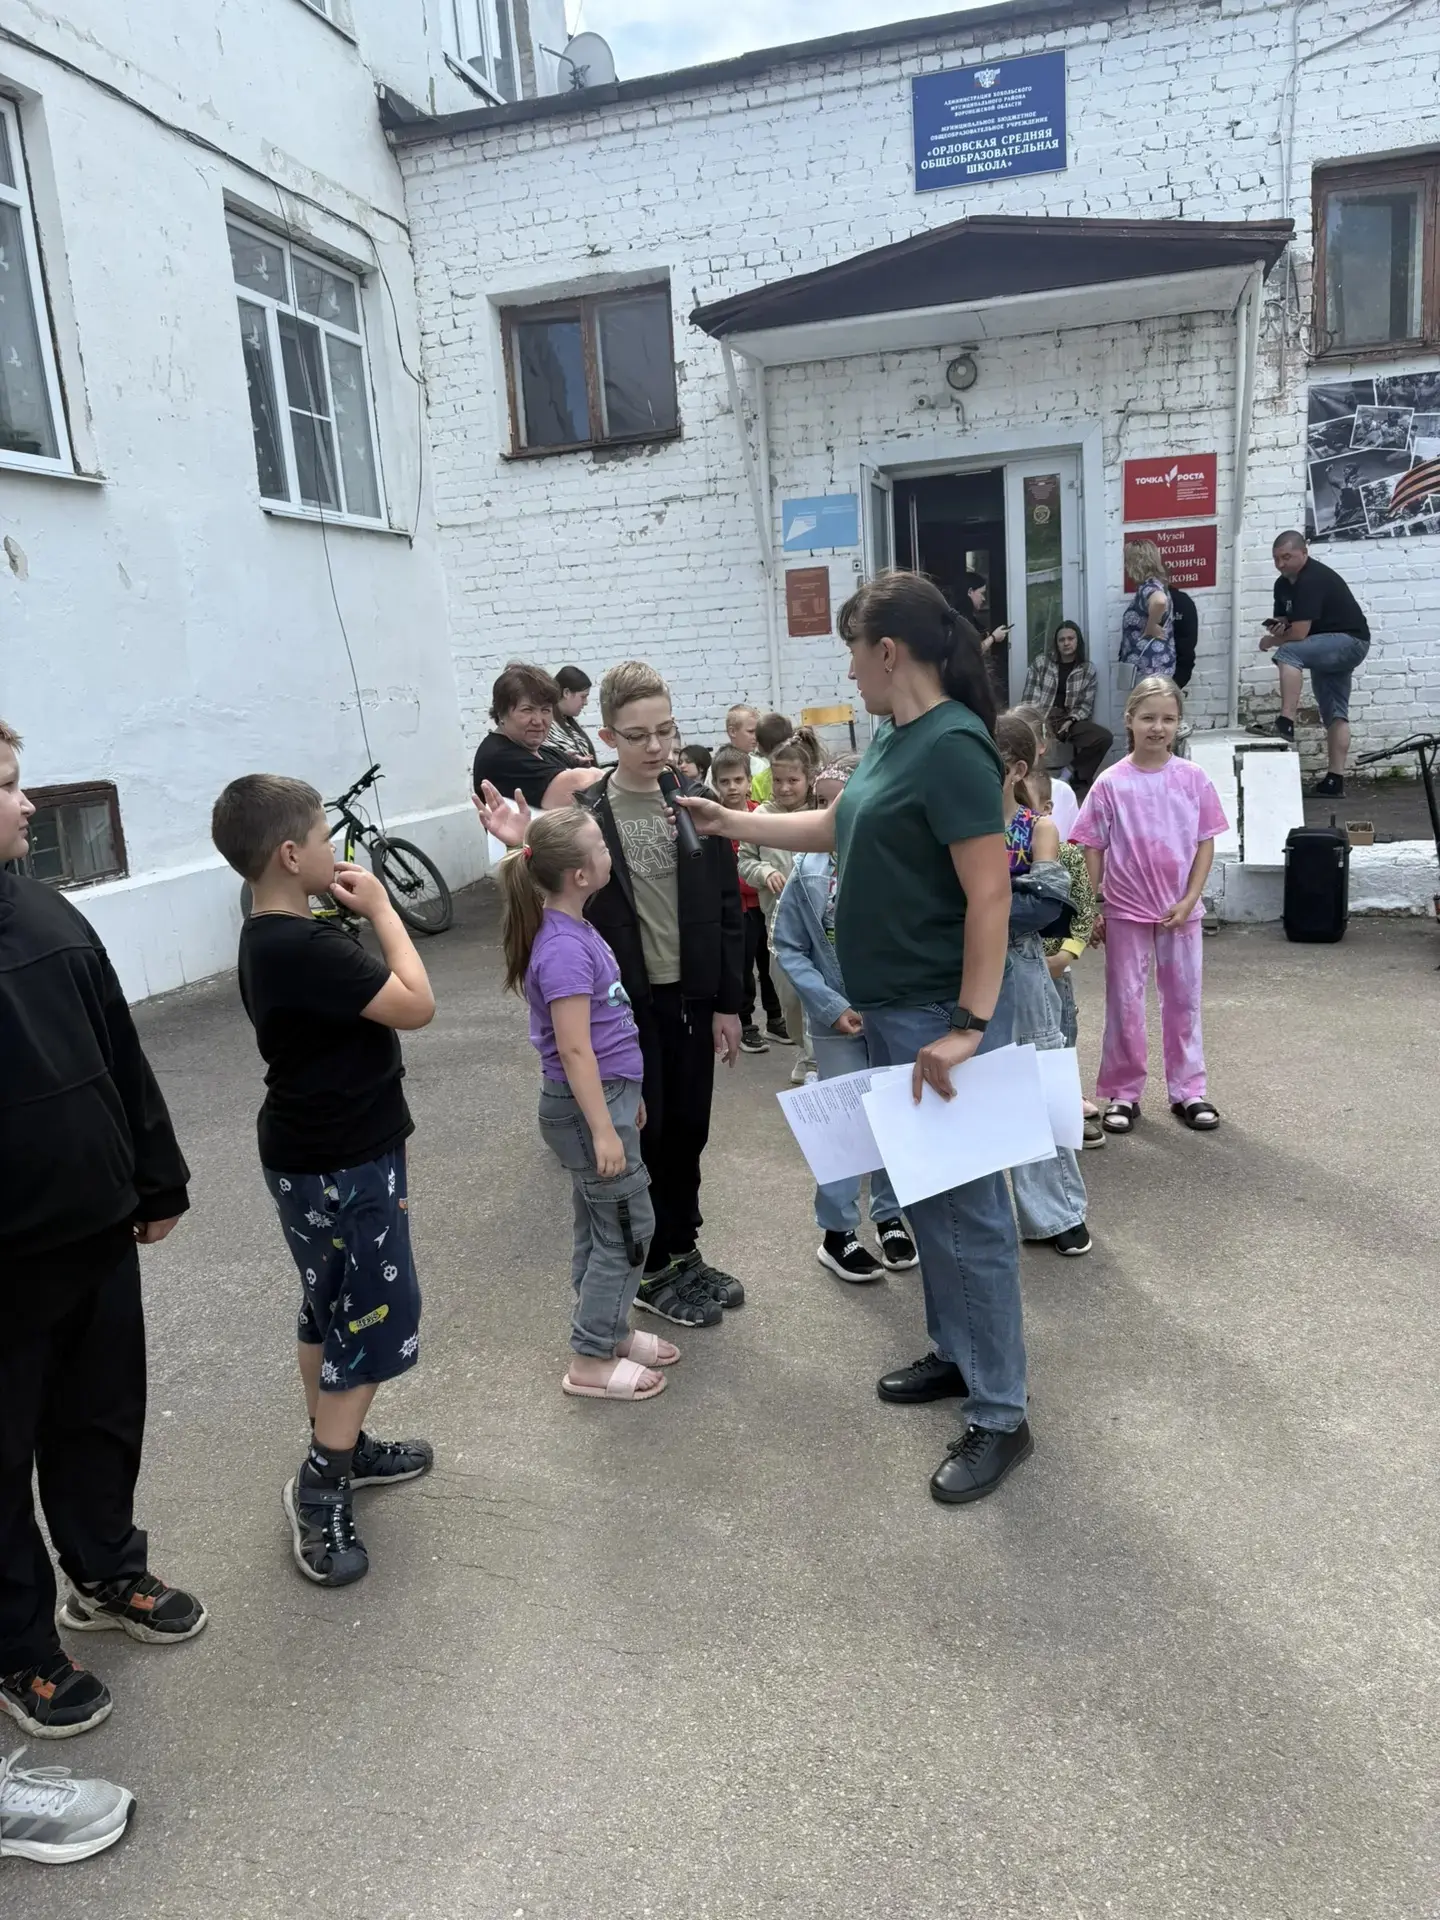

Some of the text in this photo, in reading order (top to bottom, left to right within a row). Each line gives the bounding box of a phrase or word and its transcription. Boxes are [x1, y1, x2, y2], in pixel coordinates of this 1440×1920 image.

[1001, 128, 1053, 145] СРЕДНЯЯ
[920, 139, 1059, 170] ОБЩЕОБРАЗОВАТЕЛЬНАЯ
[1135, 472, 1205, 485] ТОЧКА РОСТА
[1157, 531, 1185, 542] Музей
[1157, 544, 1195, 554] колая
[1168, 573, 1199, 583] кова
